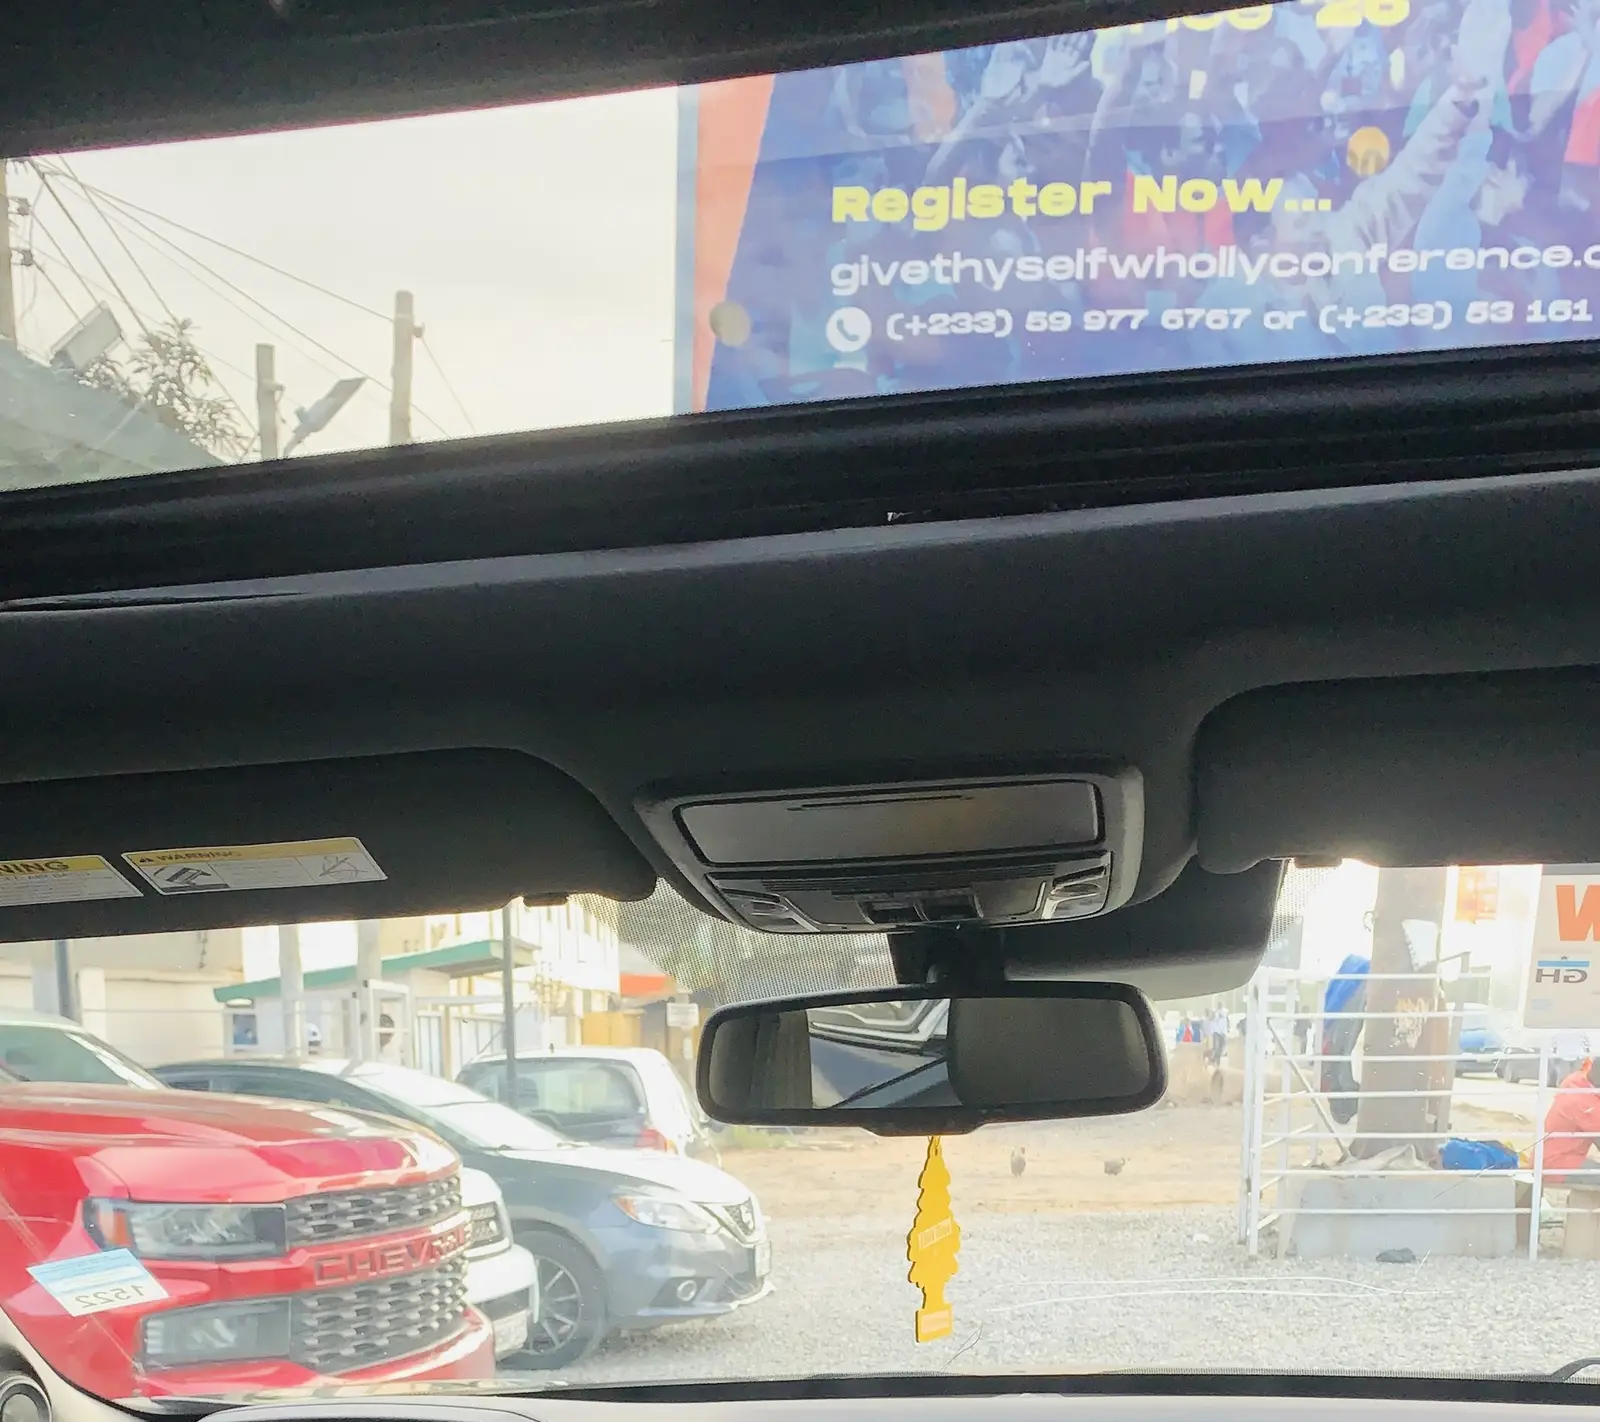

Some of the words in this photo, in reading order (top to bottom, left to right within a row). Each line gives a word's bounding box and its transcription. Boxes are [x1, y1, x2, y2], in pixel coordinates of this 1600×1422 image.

[832, 177, 1112, 232] Register
[1133, 174, 1332, 213] Now...
[886, 307, 1014, 341] (+233)
[1025, 310, 1072, 333] 59
[1083, 308, 1150, 331] 977
[1160, 306, 1252, 331] 6767
[1263, 308, 1306, 331] or
[1319, 300, 1452, 334] (+233)
[1526, 298, 1593, 323] 161
